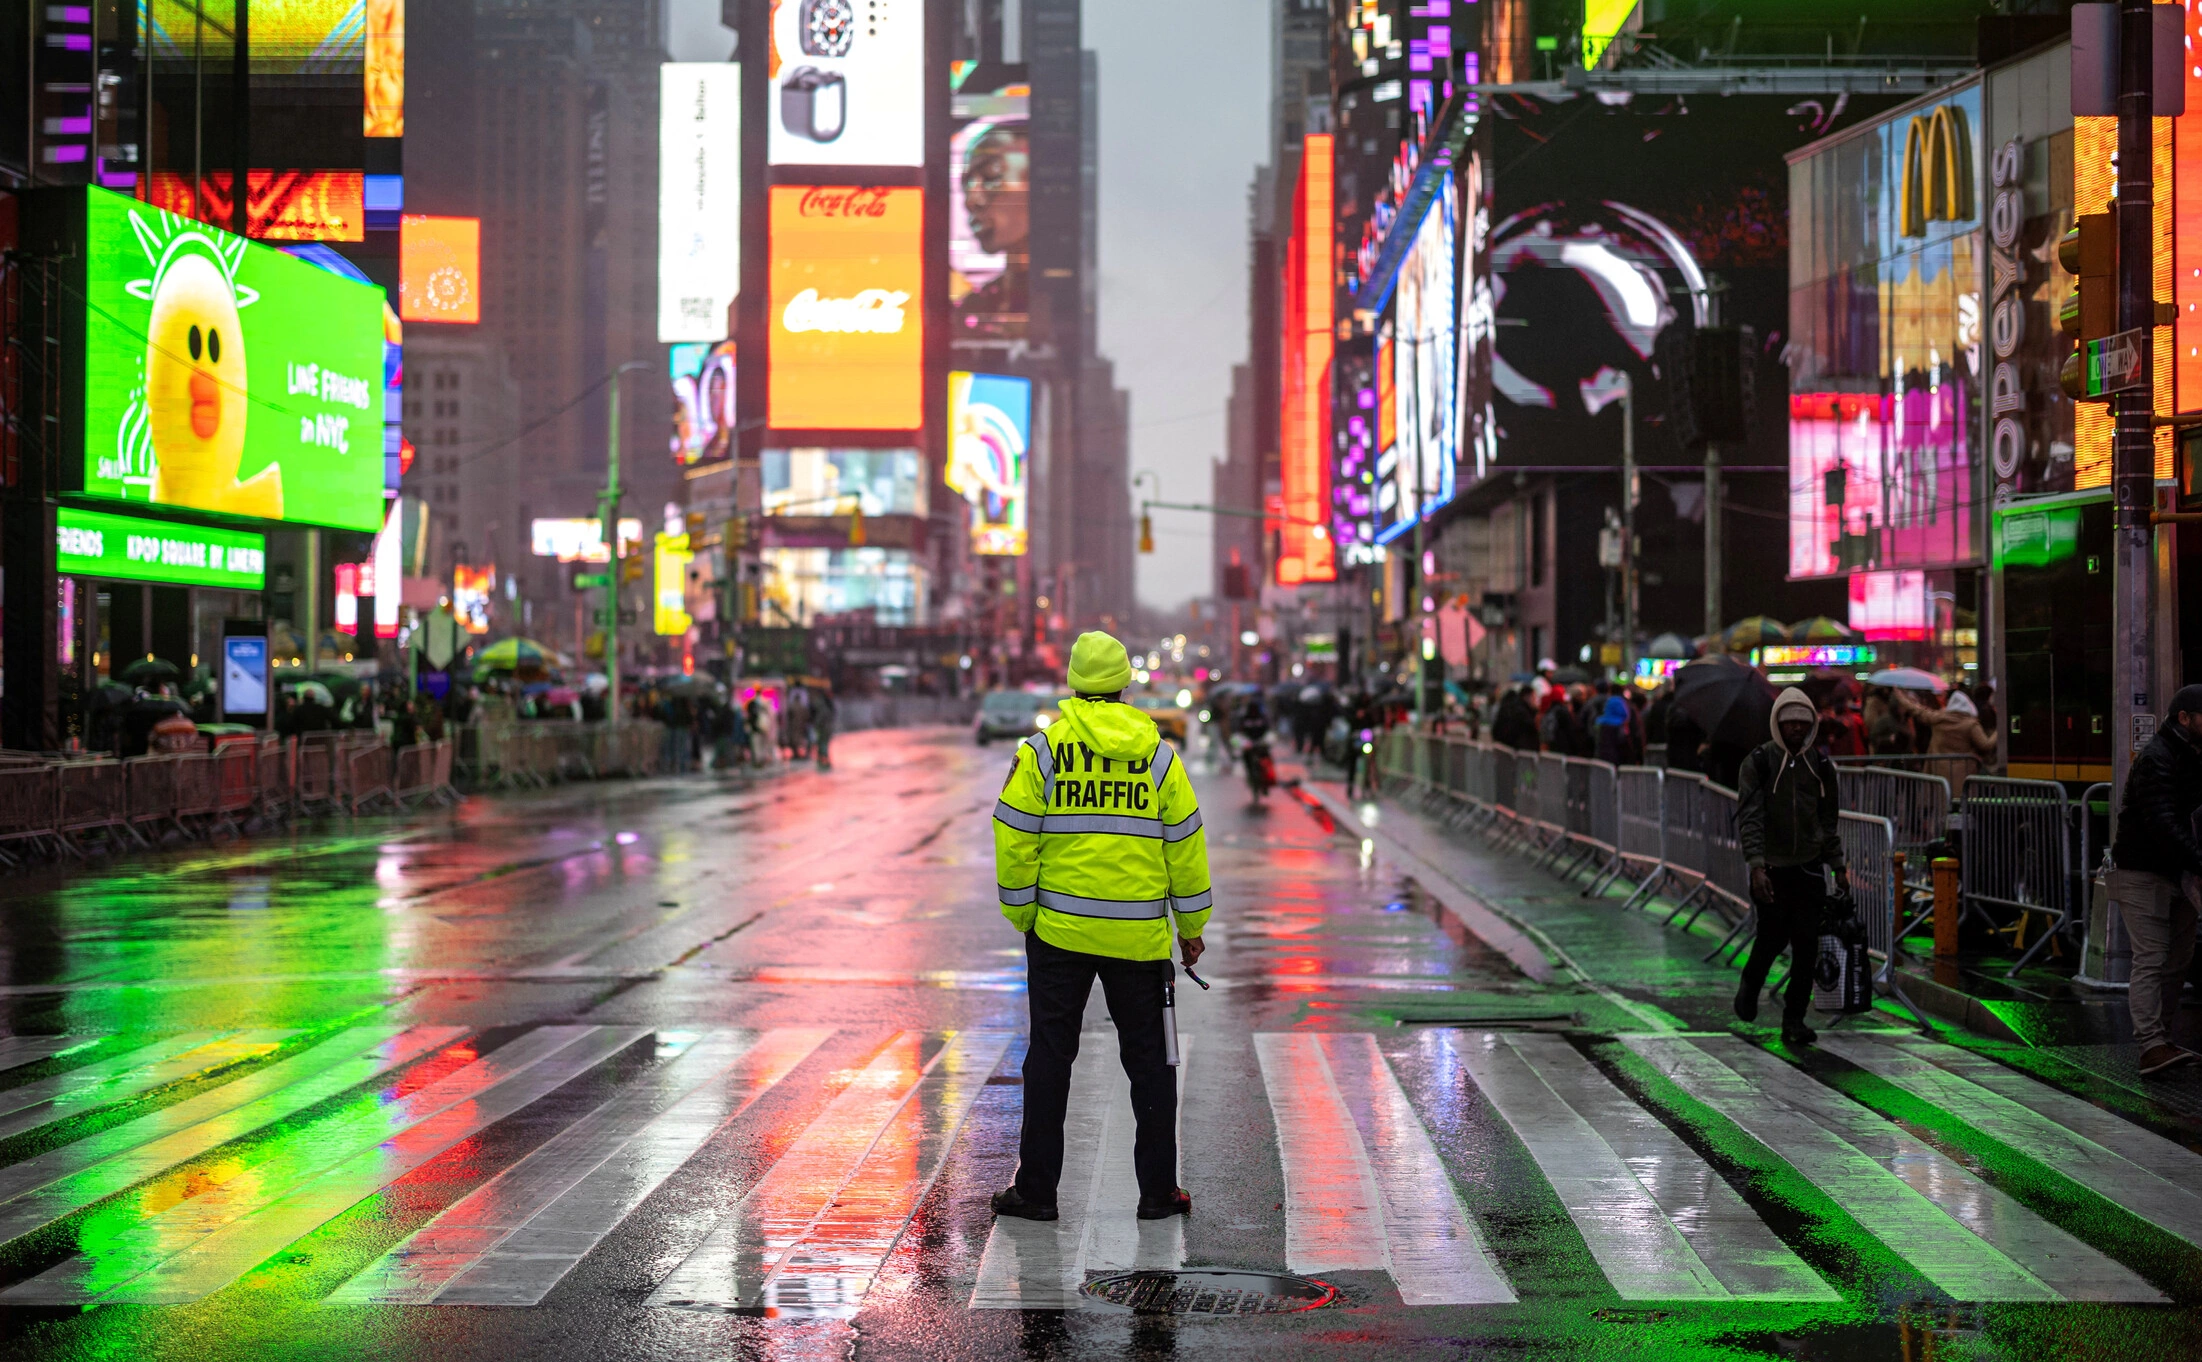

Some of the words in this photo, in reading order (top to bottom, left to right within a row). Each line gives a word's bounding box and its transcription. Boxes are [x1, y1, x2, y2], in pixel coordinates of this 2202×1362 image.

[2118, 349, 2135, 373] WAY
[287, 361, 320, 396] LINE
[321, 368, 370, 410] FRIENDS
[315, 413, 349, 455] NYC
[127, 534, 161, 563] KPOP
[161, 538, 207, 568] SQUARE
[209, 544, 224, 569] BY
[1055, 780, 1149, 810] TRAFFIC
